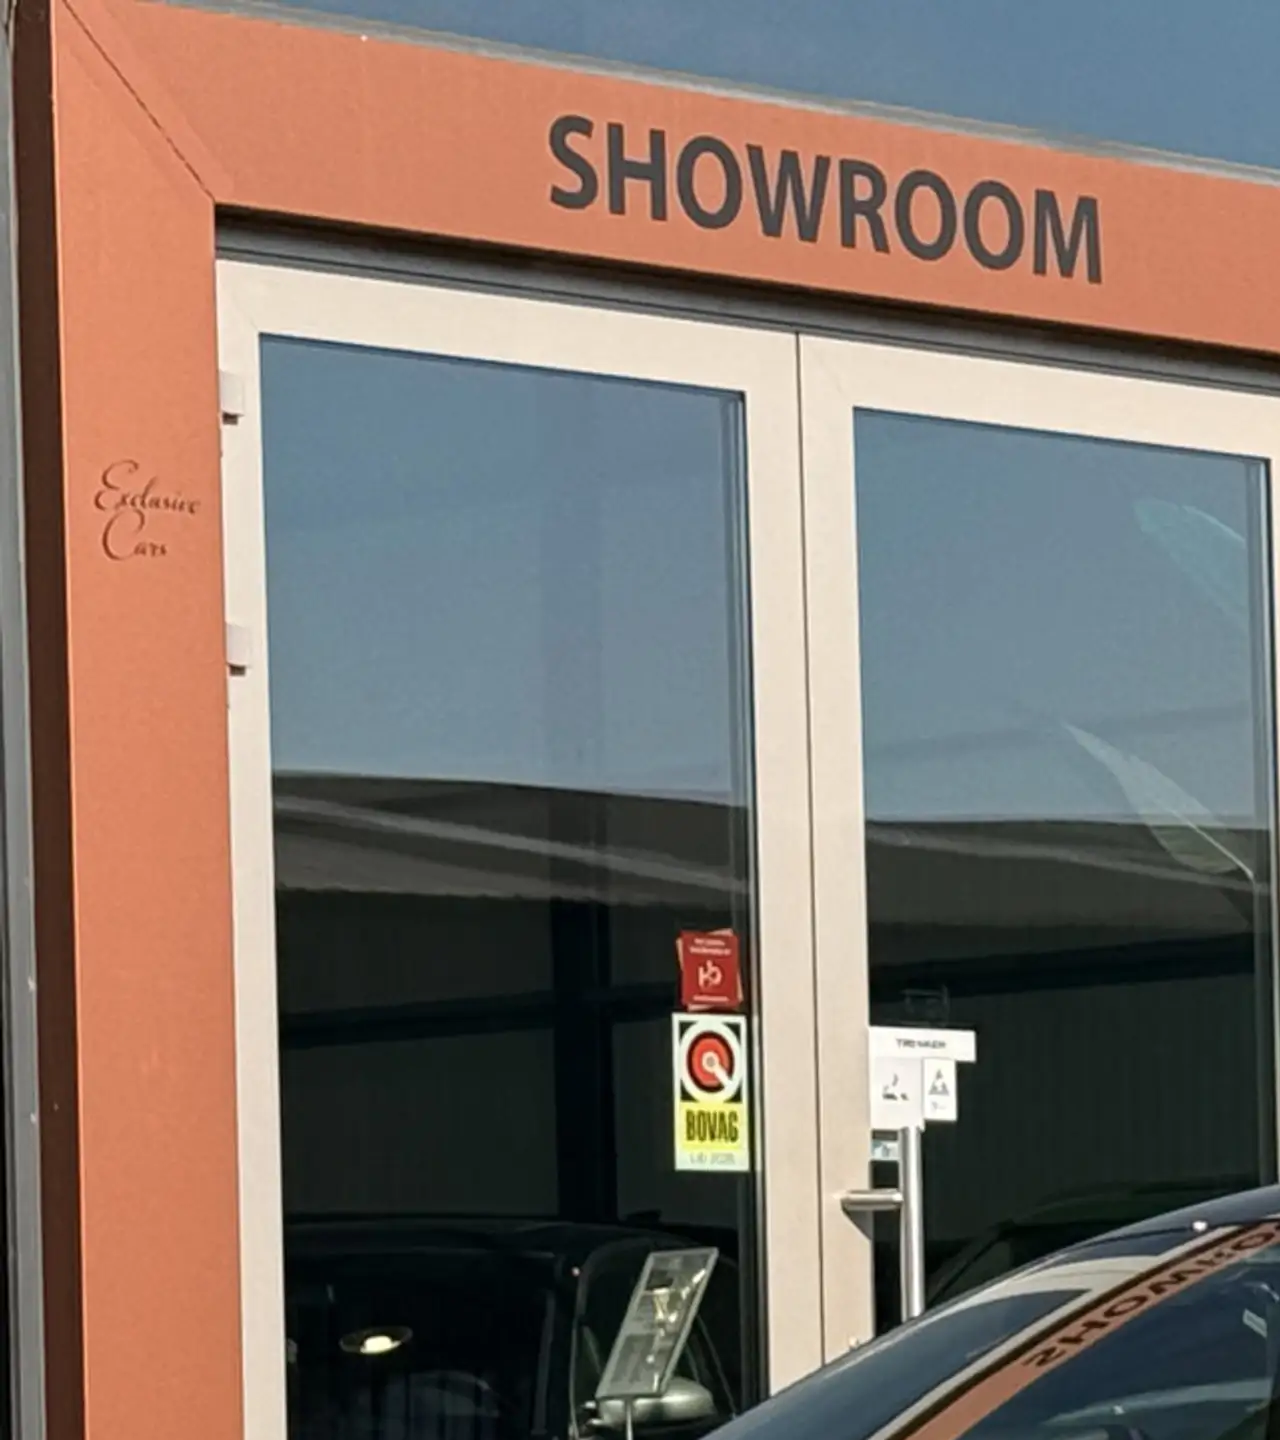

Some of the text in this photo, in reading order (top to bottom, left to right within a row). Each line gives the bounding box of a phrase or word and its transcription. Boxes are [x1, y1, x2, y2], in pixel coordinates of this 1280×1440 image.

[549, 114, 1103, 285] SHOWROOM
[94, 459, 201, 515] Exclusive
[102, 508, 168, 561] Cars
[685, 1109, 740, 1144] BOVAG
